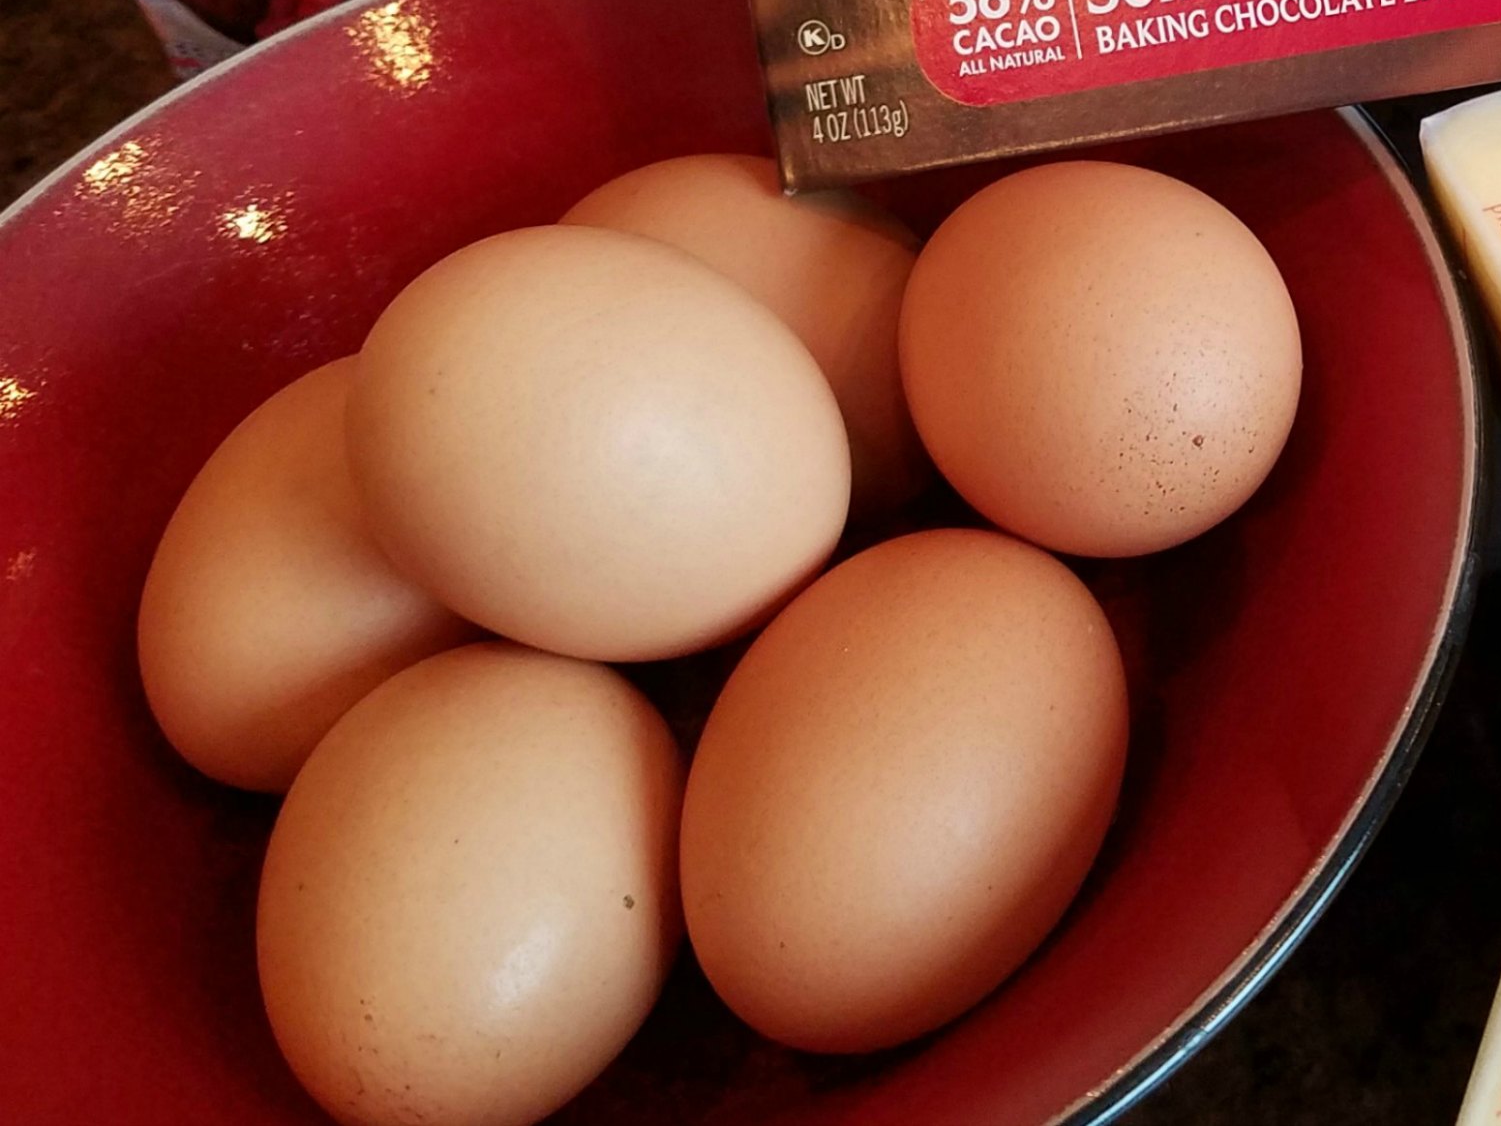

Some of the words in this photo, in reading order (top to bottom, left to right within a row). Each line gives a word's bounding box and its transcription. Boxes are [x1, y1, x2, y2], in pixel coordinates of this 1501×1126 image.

[952, 15, 1061, 56] CACAO
[1095, 9, 1210, 55] BAKING
[958, 58, 987, 77] ALL
[989, 45, 1066, 72] NATURAL
[805, 79, 838, 112] NET
[840, 74, 865, 106] WT
[813, 115, 824, 144] 4
[826, 111, 852, 143] OZ
[853, 99, 909, 139] (113g)
